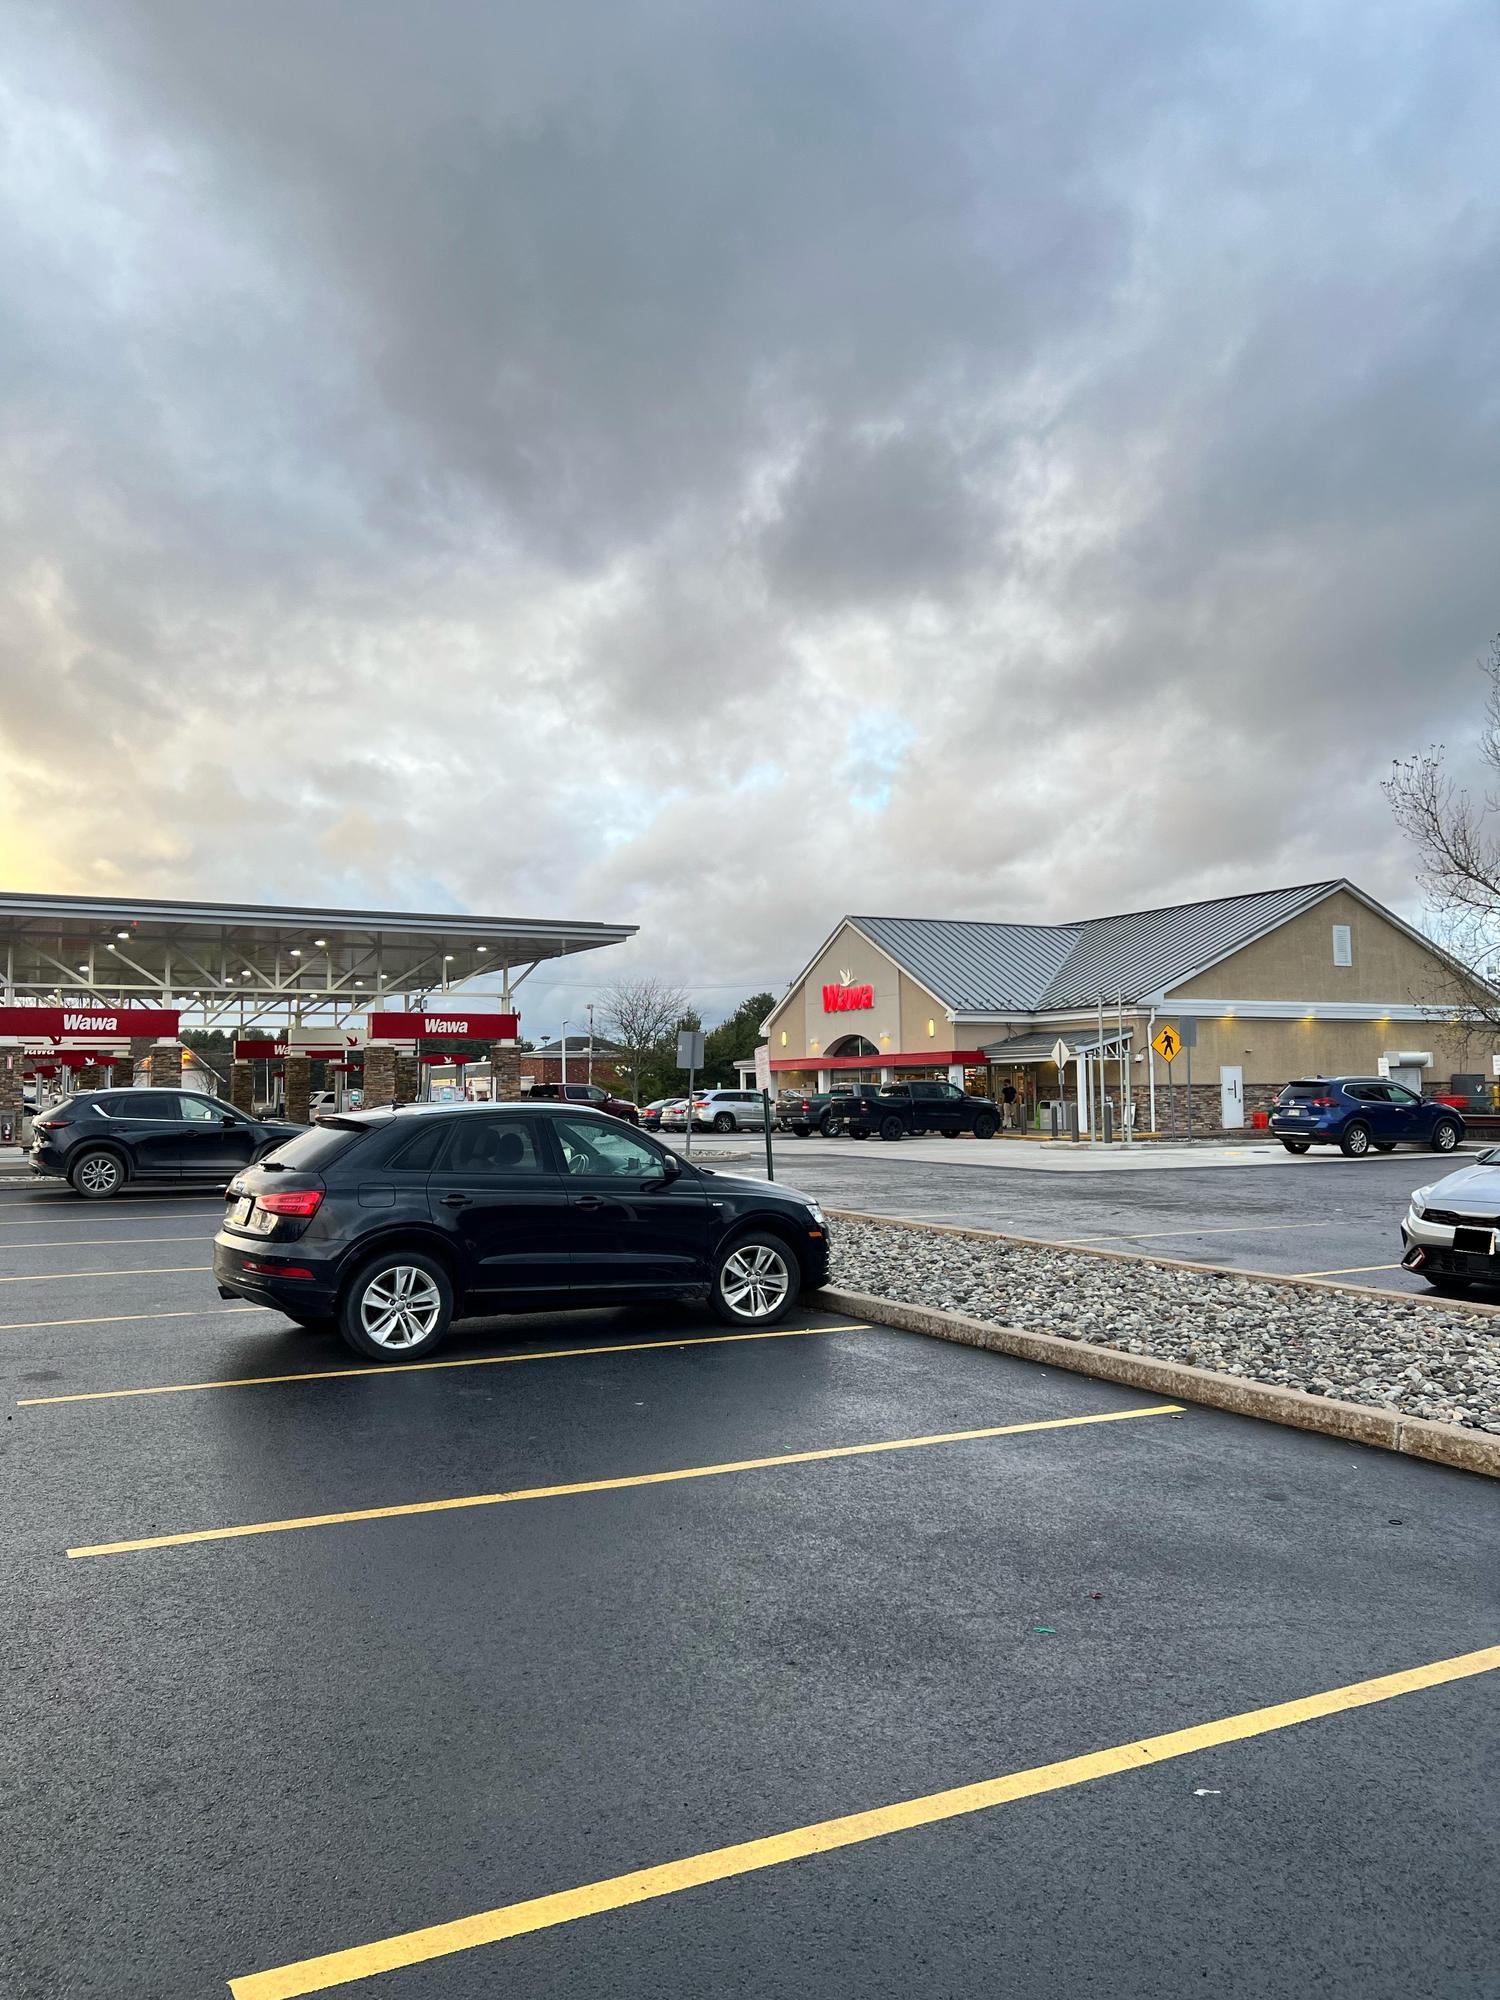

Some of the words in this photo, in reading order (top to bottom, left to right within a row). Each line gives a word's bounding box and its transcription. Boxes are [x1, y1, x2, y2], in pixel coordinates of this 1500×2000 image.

[822, 984, 874, 1013] Wawa
[64, 1014, 117, 1031] Wawa
[425, 1018, 468, 1033] Wawa
[274, 1044, 290, 1055] Wa
